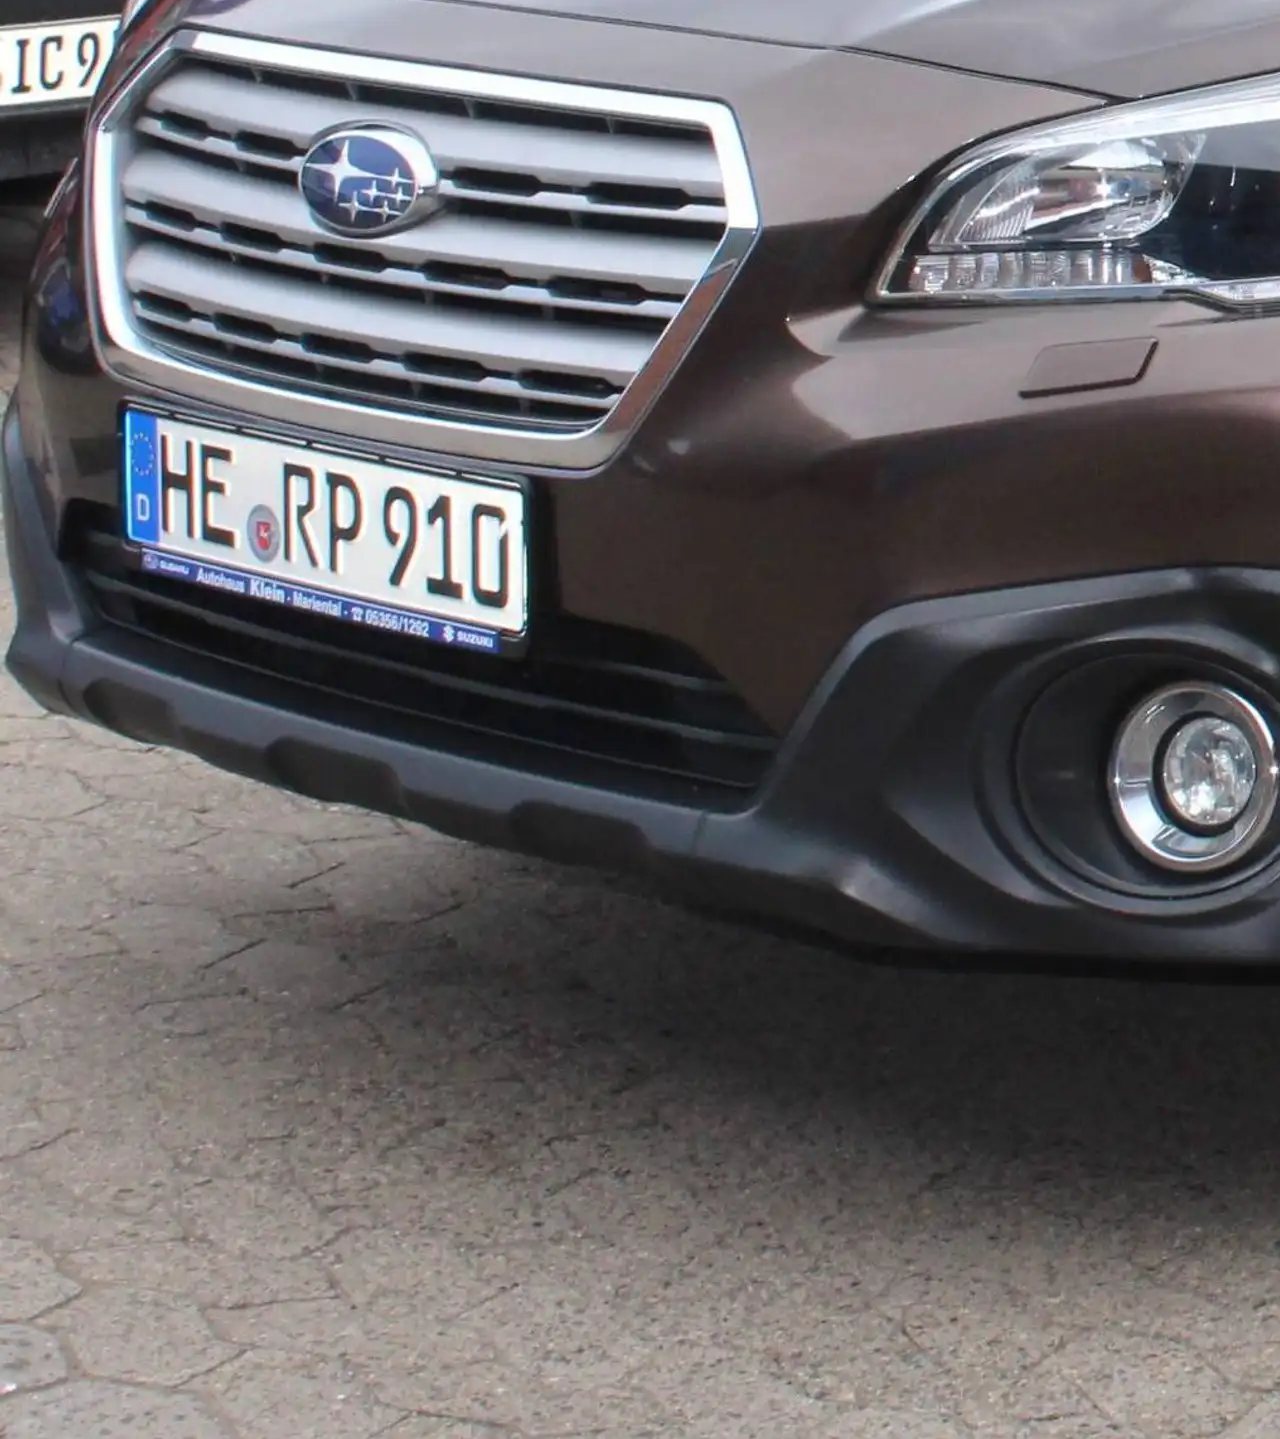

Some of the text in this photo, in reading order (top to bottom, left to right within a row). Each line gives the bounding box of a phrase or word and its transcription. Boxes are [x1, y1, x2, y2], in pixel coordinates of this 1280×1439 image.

[136, 493, 150, 521] D
[161, 433, 510, 609] HE RP 910
[249, 578, 285, 604] Klein
